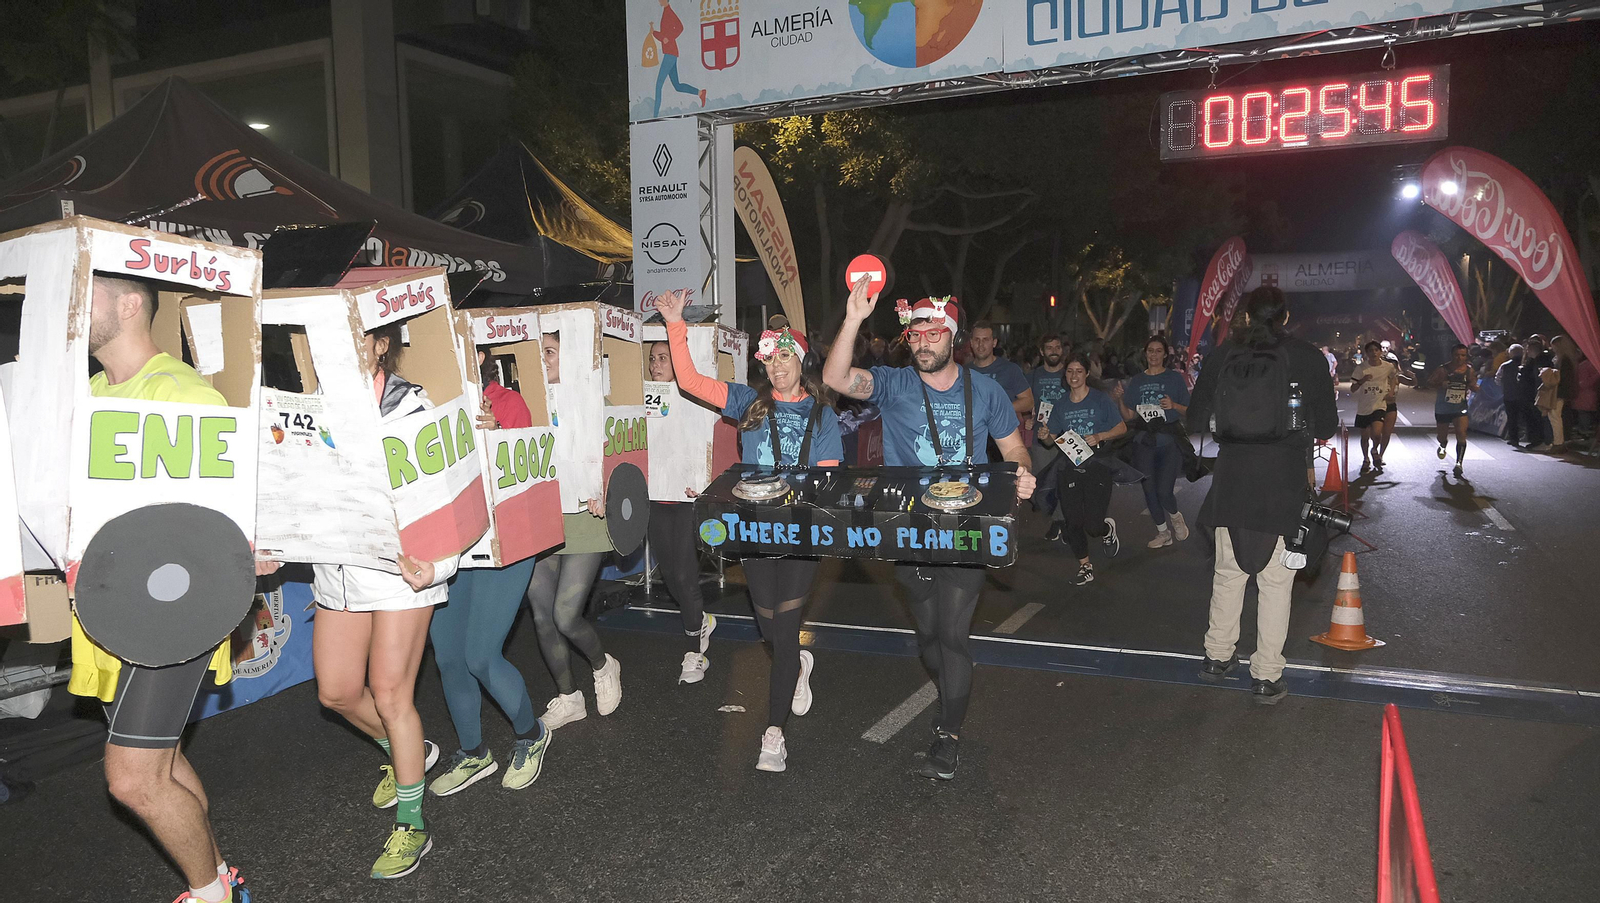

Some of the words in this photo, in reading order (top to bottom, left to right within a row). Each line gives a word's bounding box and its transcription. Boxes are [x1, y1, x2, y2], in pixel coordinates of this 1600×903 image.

[751, 6, 833, 38] ALMERÍA
[771, 32, 813, 48] CIUDAD
[639, 182, 688, 195] RENAULT
[639, 195, 654, 203] SYRSA
[641, 238, 687, 249] NISSAN
[125, 238, 232, 291] Surbús
[646, 266, 687, 275] andalmotor.es
[1295, 277, 1335, 288] CIUDAD
[375, 282, 436, 318] Surbús
[486, 316, 529, 340] Surbús
[606, 308, 635, 339] Surbús
[279, 411, 316, 431] 742
[88, 410, 237, 480] ENE
[382, 408, 476, 490] RGIA
[603, 416, 648, 457] SOLAR
[1066, 437, 1084, 455] 914
[496, 432, 557, 489] 100%
[721, 513, 802, 545] THERE
[810, 525, 834, 547] IS
[846, 527, 883, 548] NO
[896, 527, 983, 551] PLANET
[989, 525, 1009, 557] B
